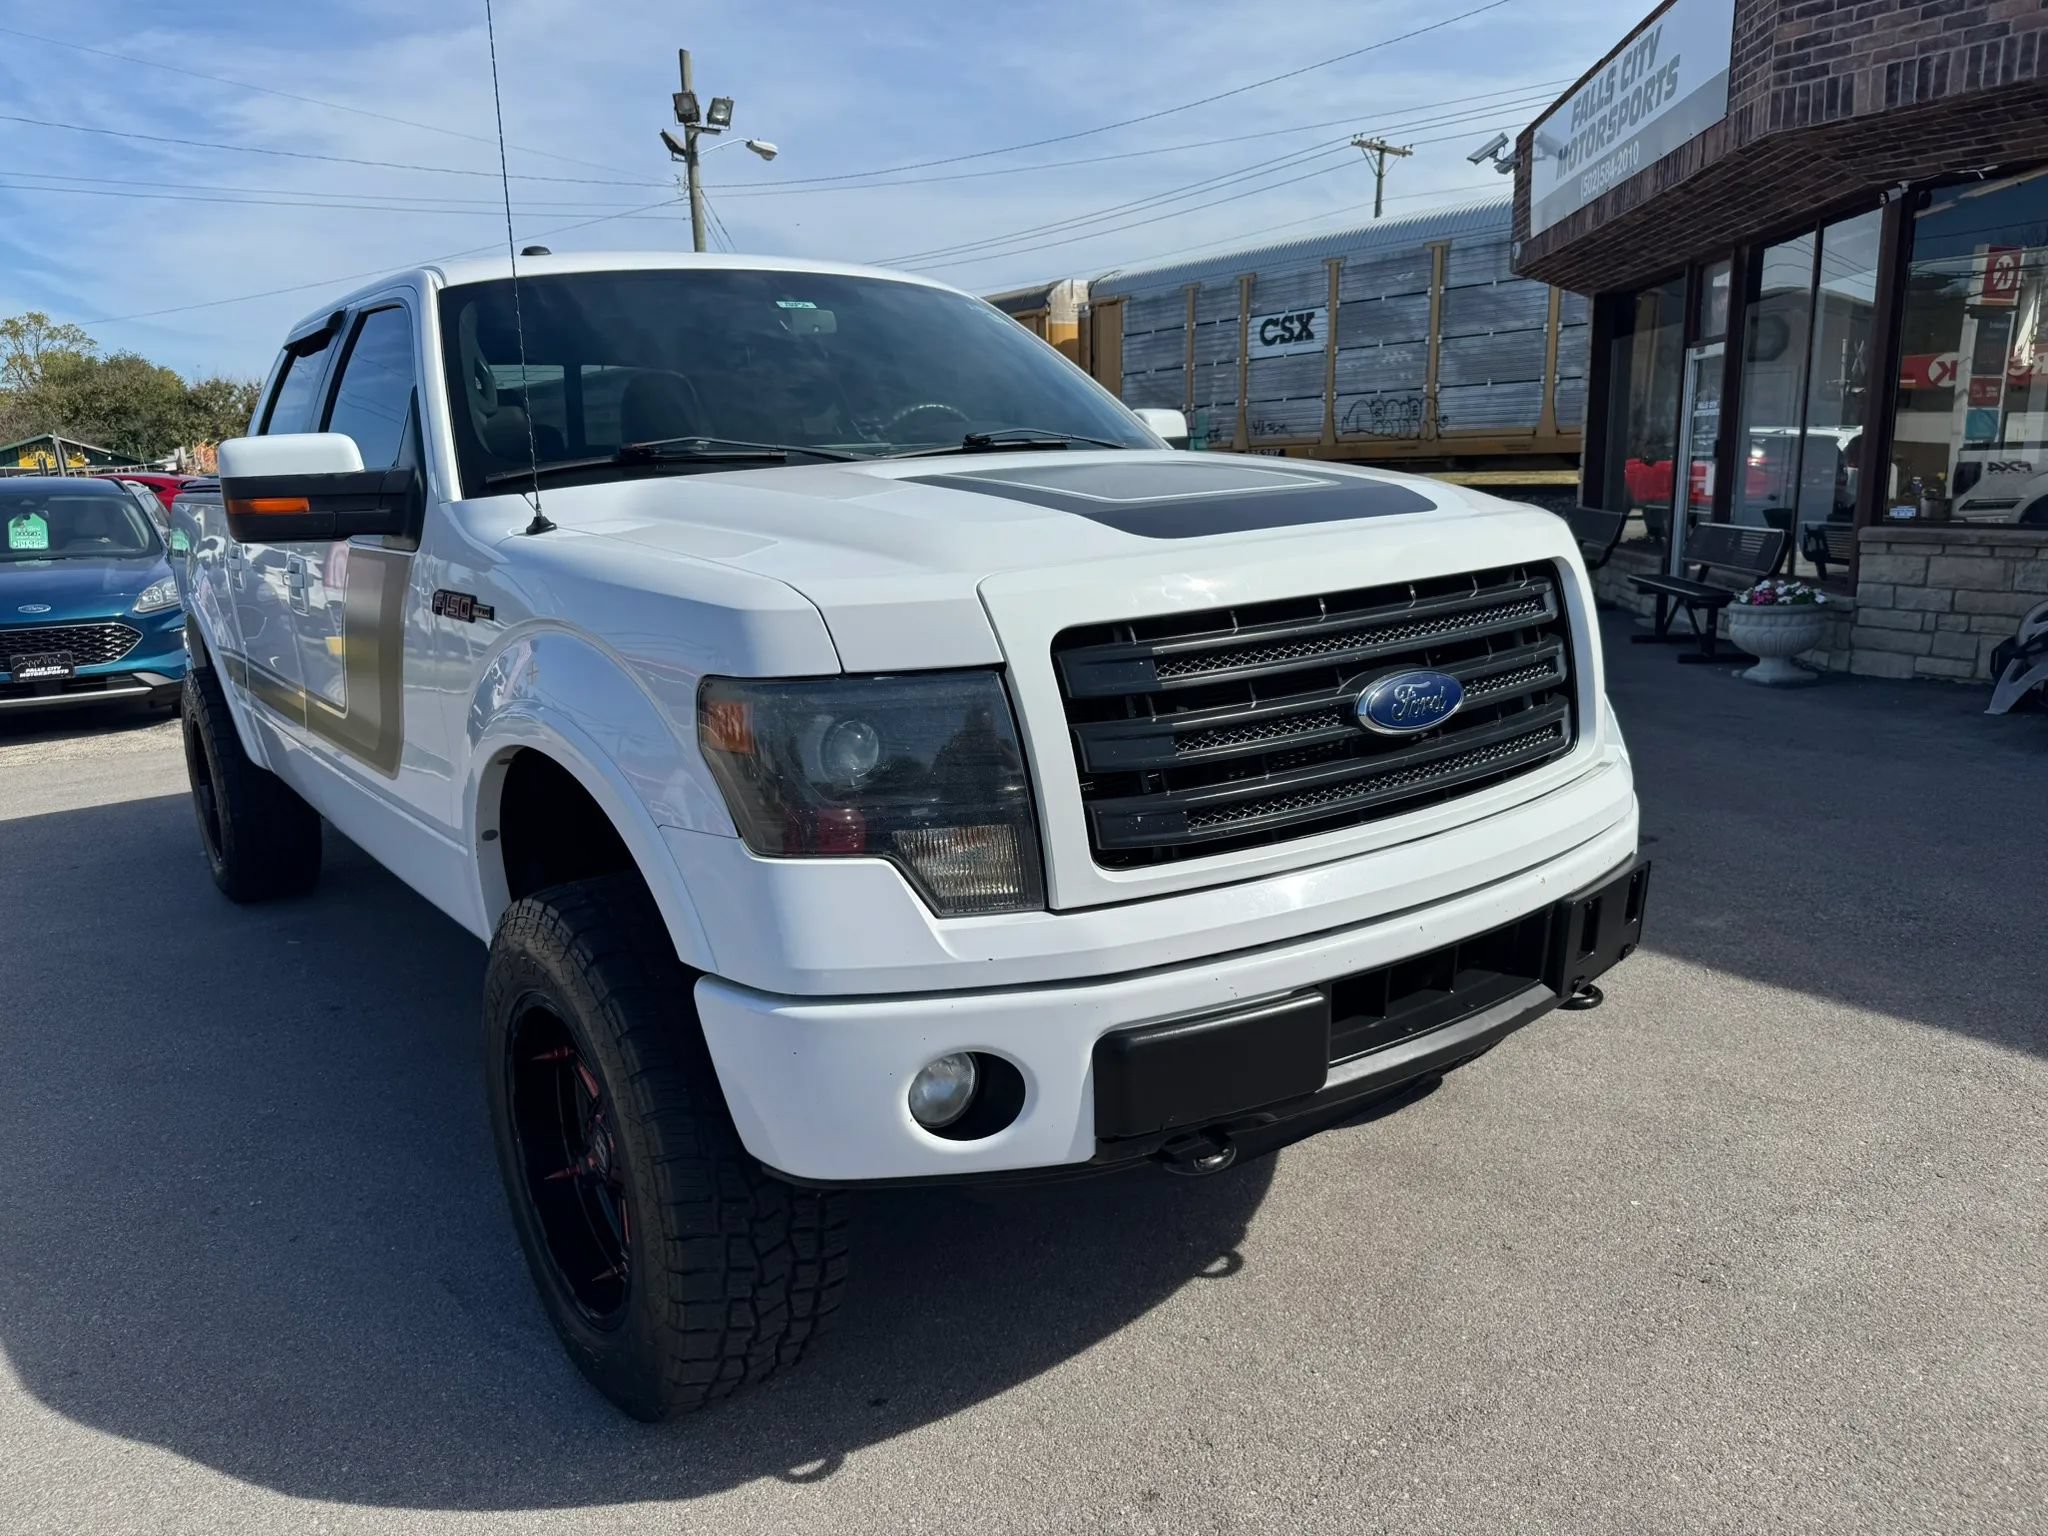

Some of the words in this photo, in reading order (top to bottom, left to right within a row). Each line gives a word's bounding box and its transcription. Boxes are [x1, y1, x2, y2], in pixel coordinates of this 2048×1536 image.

[1571, 65, 1617, 133] FALLS
[1620, 24, 1663, 92] CITY
[1556, 54, 1681, 180] MOTORSPORTS
[1260, 311, 1315, 346] CSX
[20, 669, 69, 677] MOTORSPORTS
[1391, 681, 1447, 721] Ford
